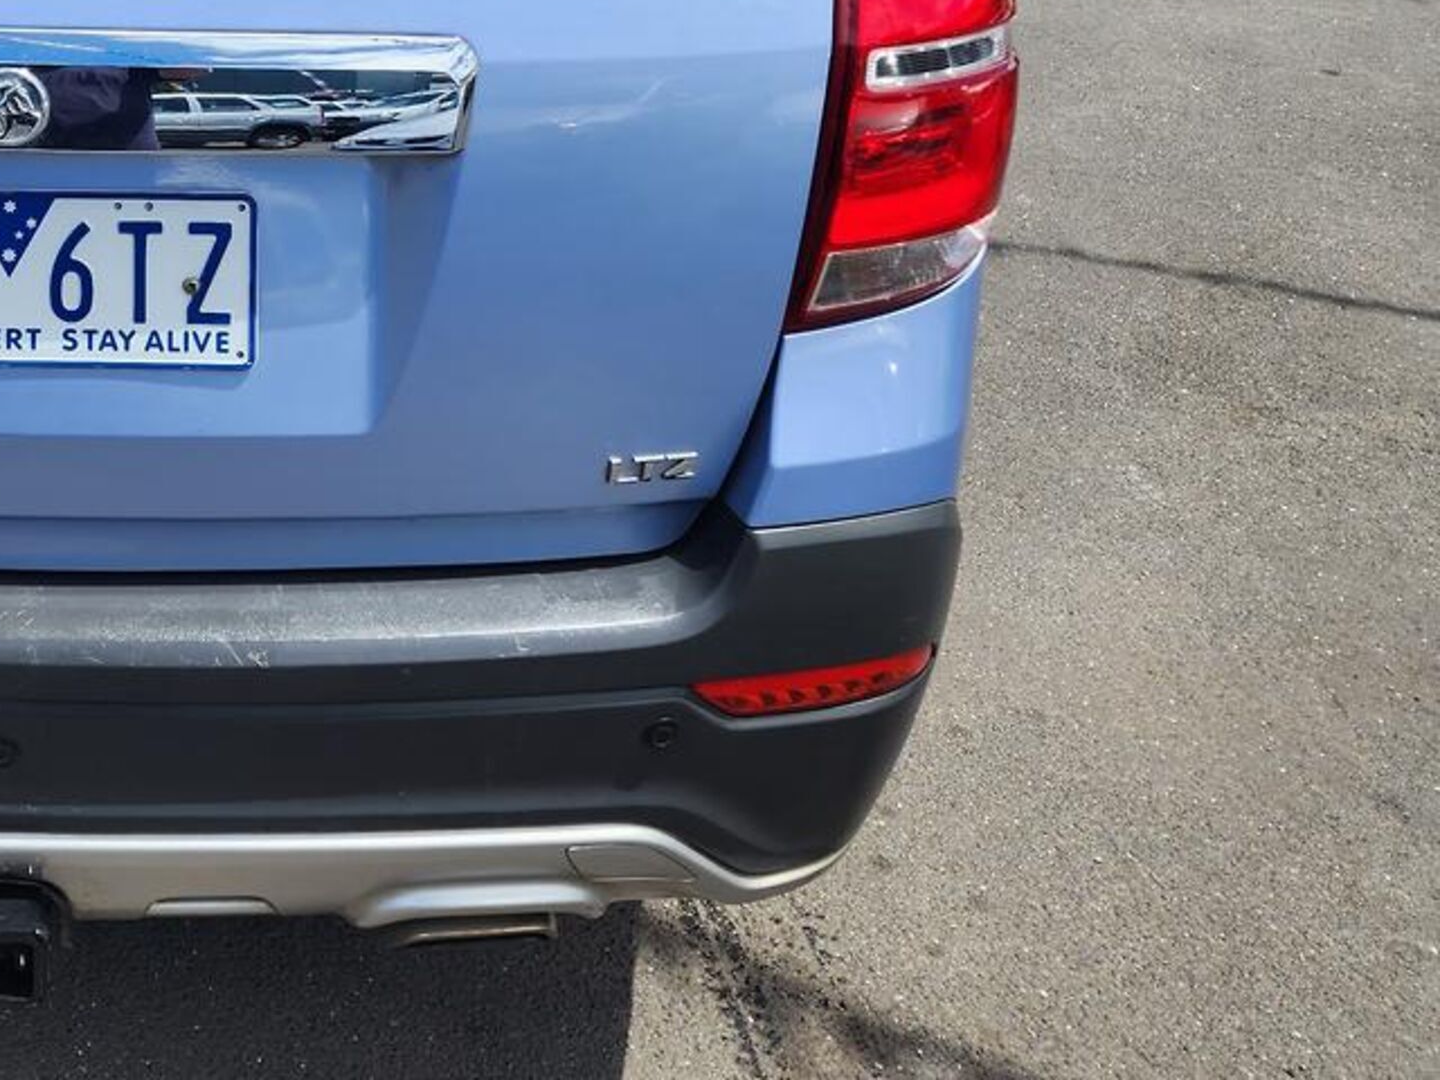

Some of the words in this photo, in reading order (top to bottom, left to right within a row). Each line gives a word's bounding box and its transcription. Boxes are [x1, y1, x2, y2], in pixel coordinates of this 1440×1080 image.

[50, 221, 233, 325] 6TZ
[62, 328, 137, 353] STAY
[143, 329, 232, 355] ALIVE
[606, 451, 699, 484] LTZ
